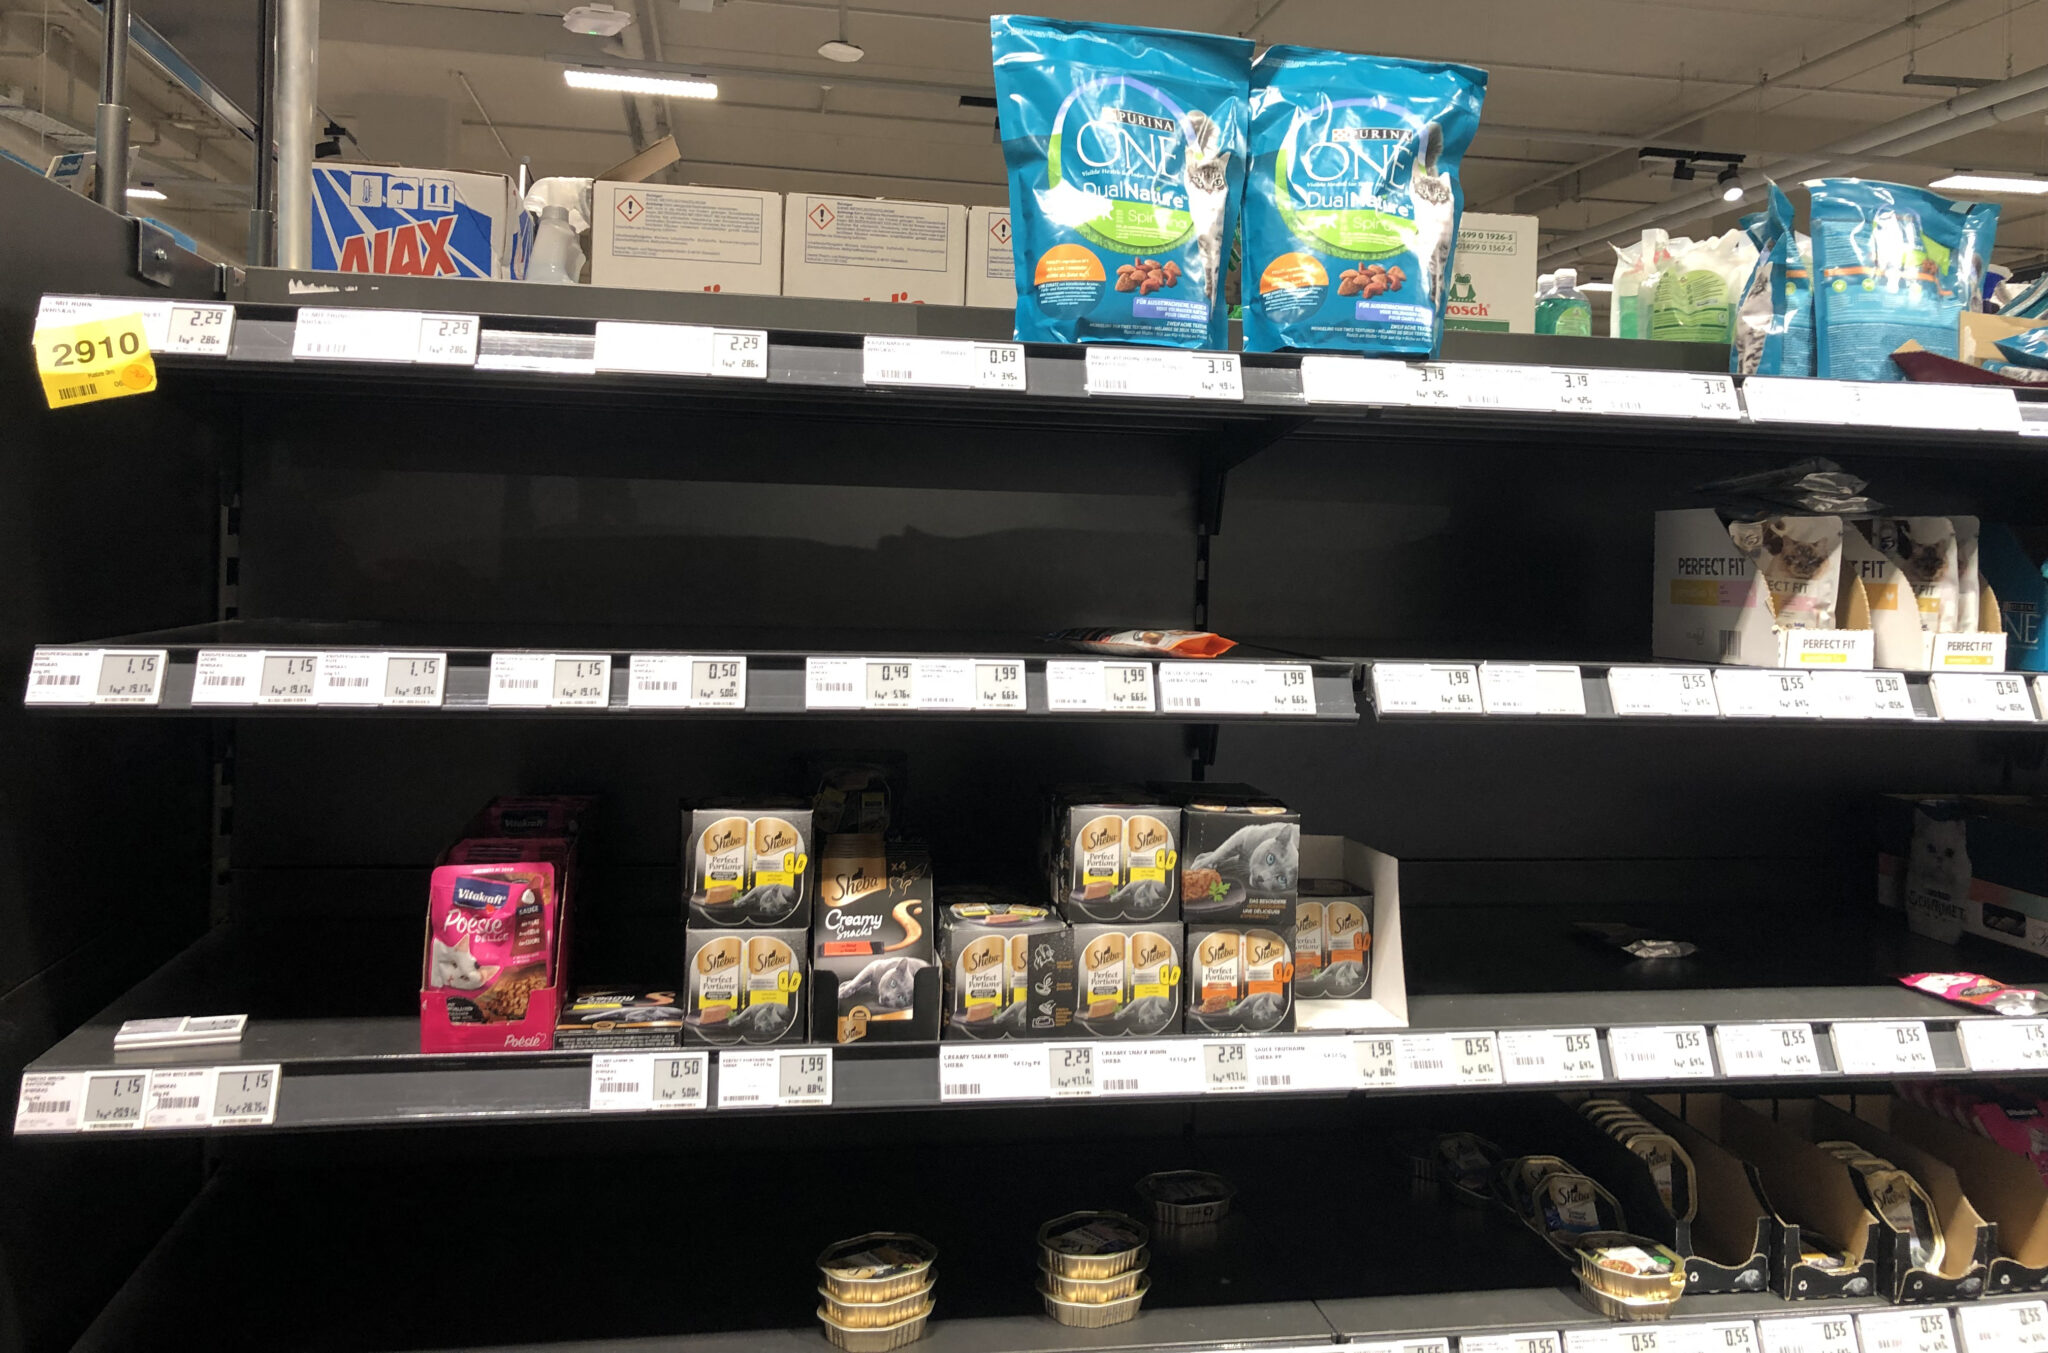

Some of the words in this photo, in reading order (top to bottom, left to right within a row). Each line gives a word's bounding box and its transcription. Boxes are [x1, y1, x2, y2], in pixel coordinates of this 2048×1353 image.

[1119, 111, 1173, 131] PURINA
[1077, 121, 1182, 180] ONE
[1301, 142, 1413, 190] ONE
[1445, 303, 1488, 316] rosch
[190, 310, 224, 327] 2.29
[439, 322, 470, 337] 2.29
[52, 332, 140, 368] 2910
[730, 336, 758, 351] 2.29
[990, 349, 1016, 364] 0.69
[1208, 360, 1232, 374] 3.19
[1422, 368, 1444, 382] 3.19
[1564, 375, 1588, 388] 3.19
[1704, 382, 1726, 395] 3.19
[1678, 557, 1725, 576] PERFECT
[1728, 557, 1745, 576] FIT
[1862, 560, 1887, 579] FIT
[2004, 611, 2038, 643] NE
[1803, 639, 1841, 649] PERFECT
[1843, 640, 1855, 649] FIT
[1947, 641, 1980, 651] PERFECT
[1981, 642, 1992, 651] FIT
[128, 658, 155, 674] 1.15
[287, 659, 313, 675] 1.15
[411, 660, 436, 677] 1.15
[577, 662, 601, 679] 1.15
[709, 663, 737, 680] 0.50
[882, 665, 909, 681] 0.49
[995, 667, 1016, 682] 1.99
[1123, 669, 1145, 684] 1.99
[1283, 672, 1304, 687] 1.99
[1448, 672, 1469, 686] 1.99
[1682, 676, 1706, 690] 0.55
[1781, 678, 1804, 691] 0.55
[1876, 679, 1899, 693] 0.90
[1996, 681, 2019, 695] 0.90
[710, 835, 741, 854] Sheba
[763, 835, 793, 854] Sheba
[1088, 834, 1118, 850] Sheba
[1135, 834, 1164, 850] Sheba
[712, 856, 738, 866] Perfect
[1087, 859, 1118, 867] Portions
[1089, 852, 1115, 862] Perfect
[709, 861, 742, 871] Portions
[891, 861, 907, 872] x4
[831, 872, 879, 901] Sheba
[457, 888, 506, 905] Vitakraft
[519, 906, 538, 915] SAUCE
[444, 908, 504, 935] Poésie
[825, 908, 883, 930] Creamy
[1334, 917, 1360, 934] Sheba
[836, 927, 874, 941] Snacks
[969, 953, 1000, 972] Sheba
[1092, 952, 1121, 969] Sheba
[1138, 951, 1167, 967] Sheba
[1205, 947, 1235, 964] Sheba
[1251, 946, 1280, 964] Sheba
[704, 955, 735, 973] Sheba
[757, 954, 787, 973] Sheba
[1208, 967, 1232, 976] Perfect
[706, 976, 732, 985] Perfect
[971, 973, 997, 982] Perfect
[1091, 977, 1122, 986] Portions
[1094, 971, 1119, 980] Perfect
[1205, 973, 1236, 982] Portions
[703, 982, 736, 991] Portions
[968, 980, 1000, 989] Portions
[504, 1034, 541, 1048] Poésie
[1566, 1035, 1590, 1052] 0.55
[1676, 1033, 1700, 1050] 0.55
[1782, 1030, 1806, 1047] 0.55
[1896, 1029, 1920, 1044] 0.55
[1218, 1046, 1243, 1063] 2.29
[1371, 1042, 1392, 1058] 1.99
[1465, 1040, 1490, 1056] 0.55
[801, 1057, 824, 1074] 1.99
[1064, 1050, 1090, 1067] 2.29
[671, 1060, 699, 1079] 0.50
[113, 1078, 140, 1097] 1.15
[242, 1073, 268, 1092] 1.15
[1557, 1187, 1591, 1206] Sheba
[1872, 1188, 1907, 1210] Sheba
[1920, 1317, 1944, 1334] 0.55
[2019, 1309, 2041, 1326] 0.55
[1725, 1328, 1750, 1347] 0.55
[1824, 1322, 1847, 1341] 0.55
[1632, 1334, 1656, 1352] 0.55
